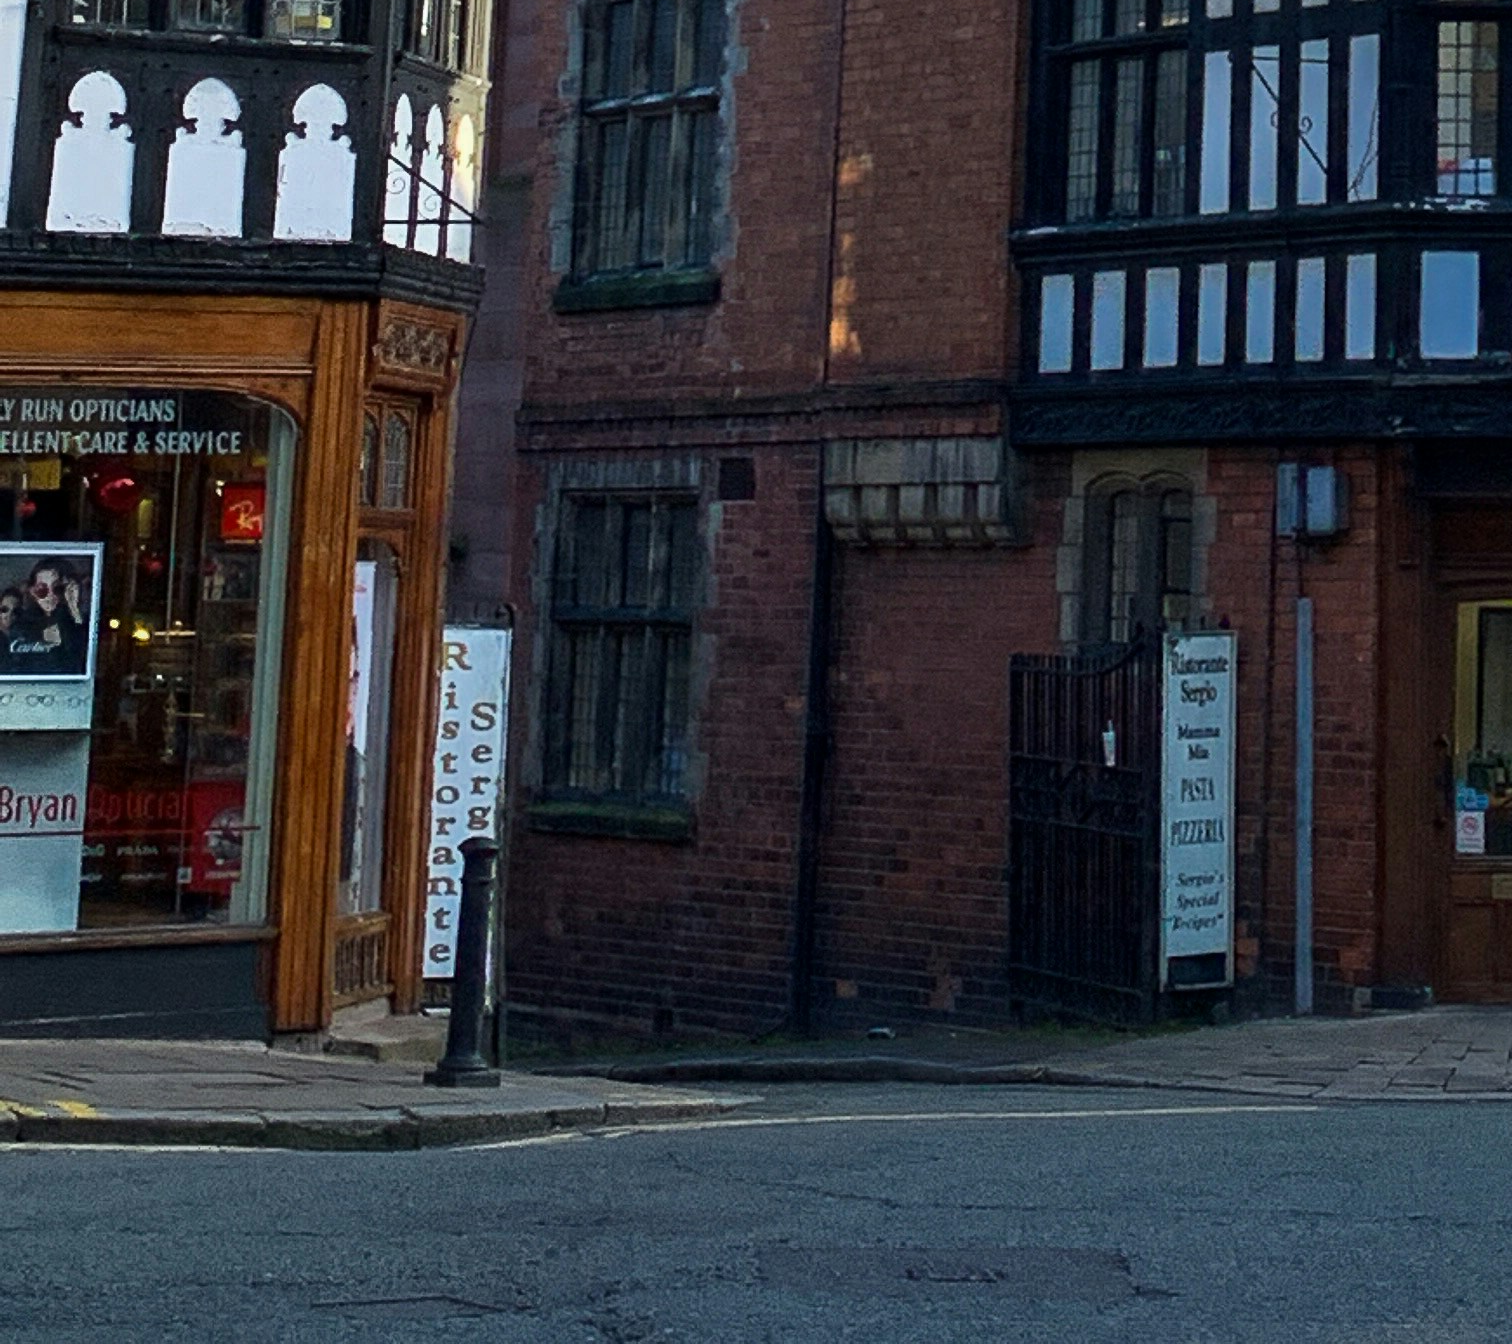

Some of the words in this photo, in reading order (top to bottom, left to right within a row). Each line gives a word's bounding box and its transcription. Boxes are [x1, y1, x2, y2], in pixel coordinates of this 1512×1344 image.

[21, 398, 64, 423] RUN
[70, 398, 176, 423] OPTICIANS
[0, 430, 72, 454] ELLENT
[77, 430, 128, 454] CARE
[133, 431, 151, 454] &
[154, 430, 242, 454] SERVICE
[1181, 680, 1217, 707] Sergio
[467, 702, 498, 831] Serg
[427, 641, 472, 963] Ristorante
[1181, 777, 1215, 802] PASTA
[0, 785, 77, 828] Bryan
[1171, 818, 1224, 846] PIZZERIA
